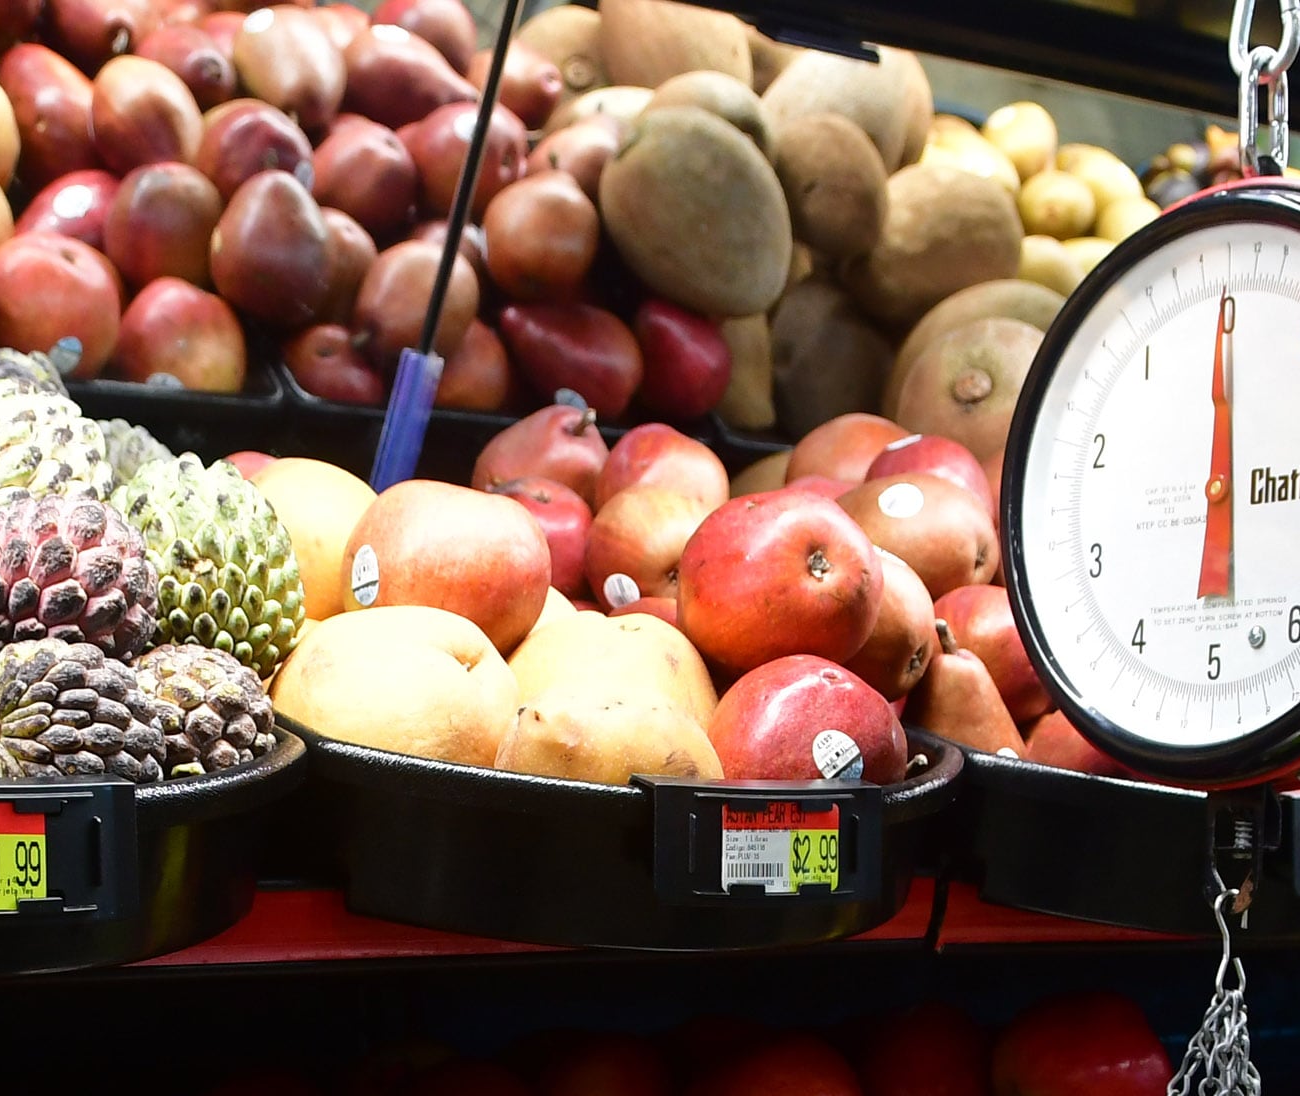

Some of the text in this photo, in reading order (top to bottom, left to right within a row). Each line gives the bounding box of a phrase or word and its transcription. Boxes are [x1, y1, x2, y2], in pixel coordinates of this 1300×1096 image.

[1223, 296, 1235, 334] 0
[1093, 433, 1105, 469] 2
[1089, 542, 1102, 578] 3
[1131, 618, 1146, 654] 4
[1207, 643, 1221, 680] 5
[792, 832, 838, 877] $2.99
